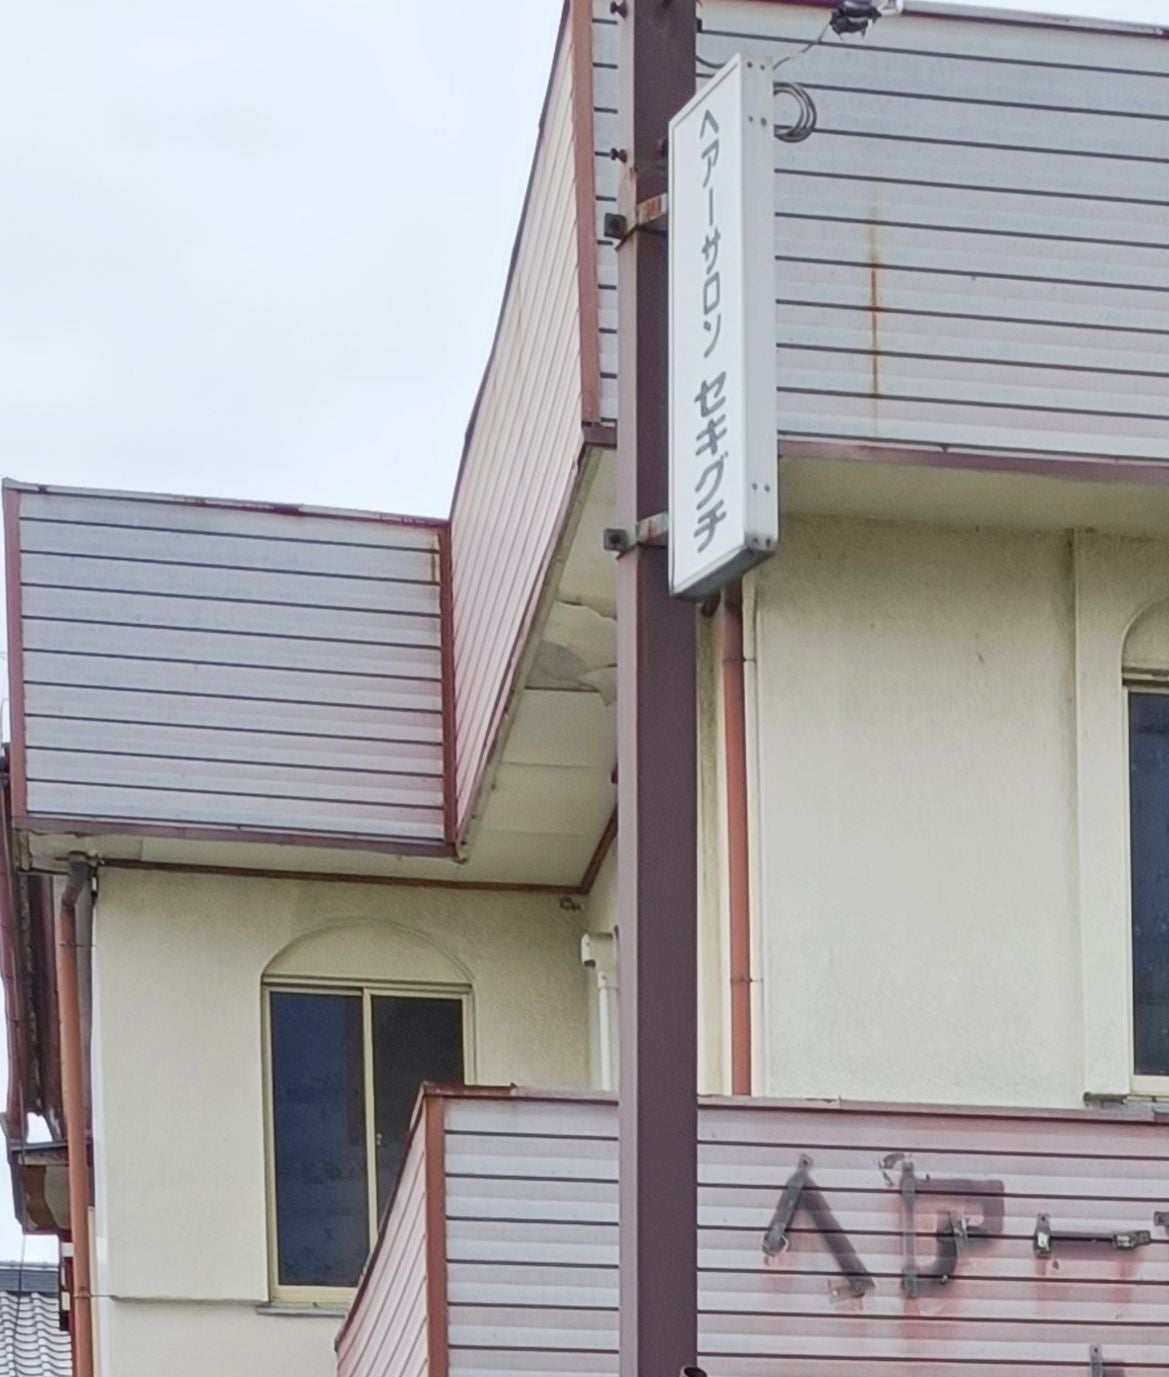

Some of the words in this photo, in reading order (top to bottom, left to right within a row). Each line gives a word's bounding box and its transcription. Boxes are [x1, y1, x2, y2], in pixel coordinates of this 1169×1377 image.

[699, 108, 721, 359] ヘアーサロン
[694, 371, 728, 553] セキグチ
